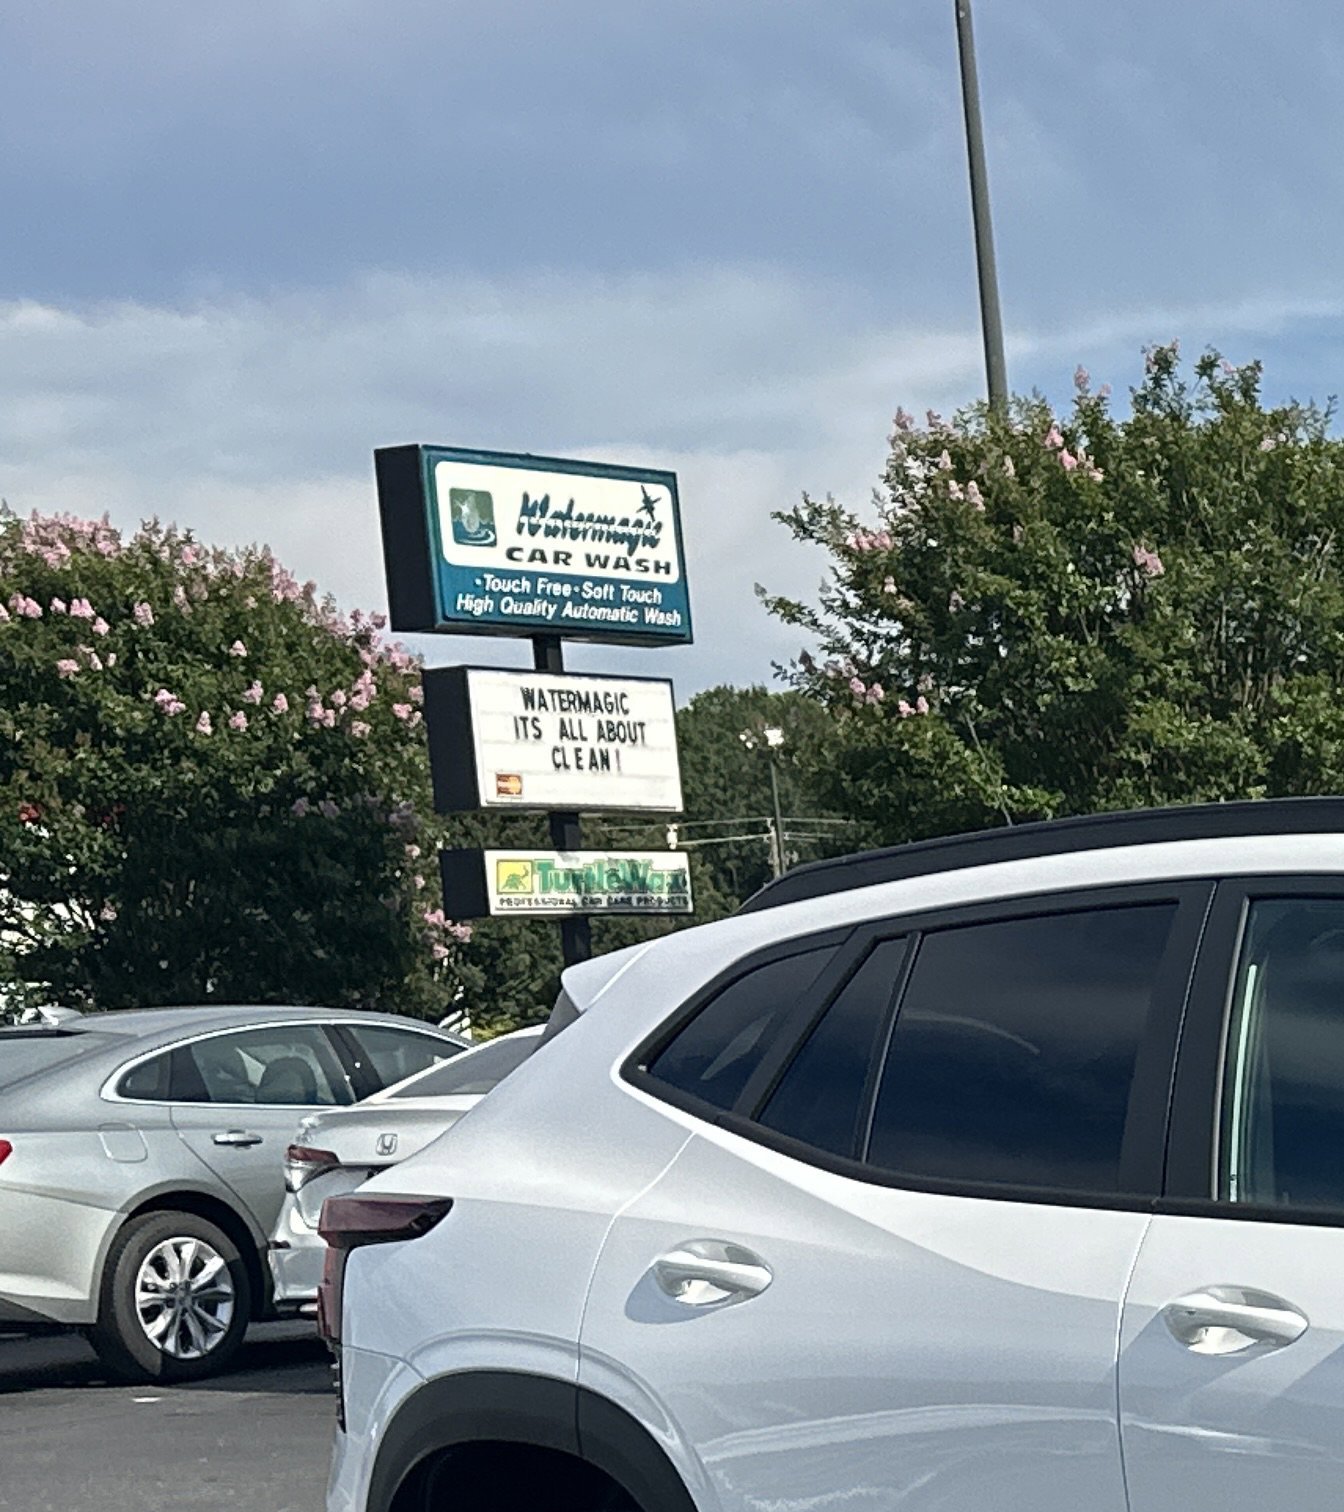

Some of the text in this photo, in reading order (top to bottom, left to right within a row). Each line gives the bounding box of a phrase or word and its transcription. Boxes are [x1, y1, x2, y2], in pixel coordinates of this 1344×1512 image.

[516, 491, 664, 556] Watermagic
[506, 547, 672, 576] CAR WASH
[483, 573, 531, 595] Touch
[621, 585, 662, 605] Touch
[457, 594, 681, 626] High Quality Automatic Wash
[520, 687, 629, 716] WATERMAGIC
[514, 716, 646, 745] ITS ALL ABOUT
